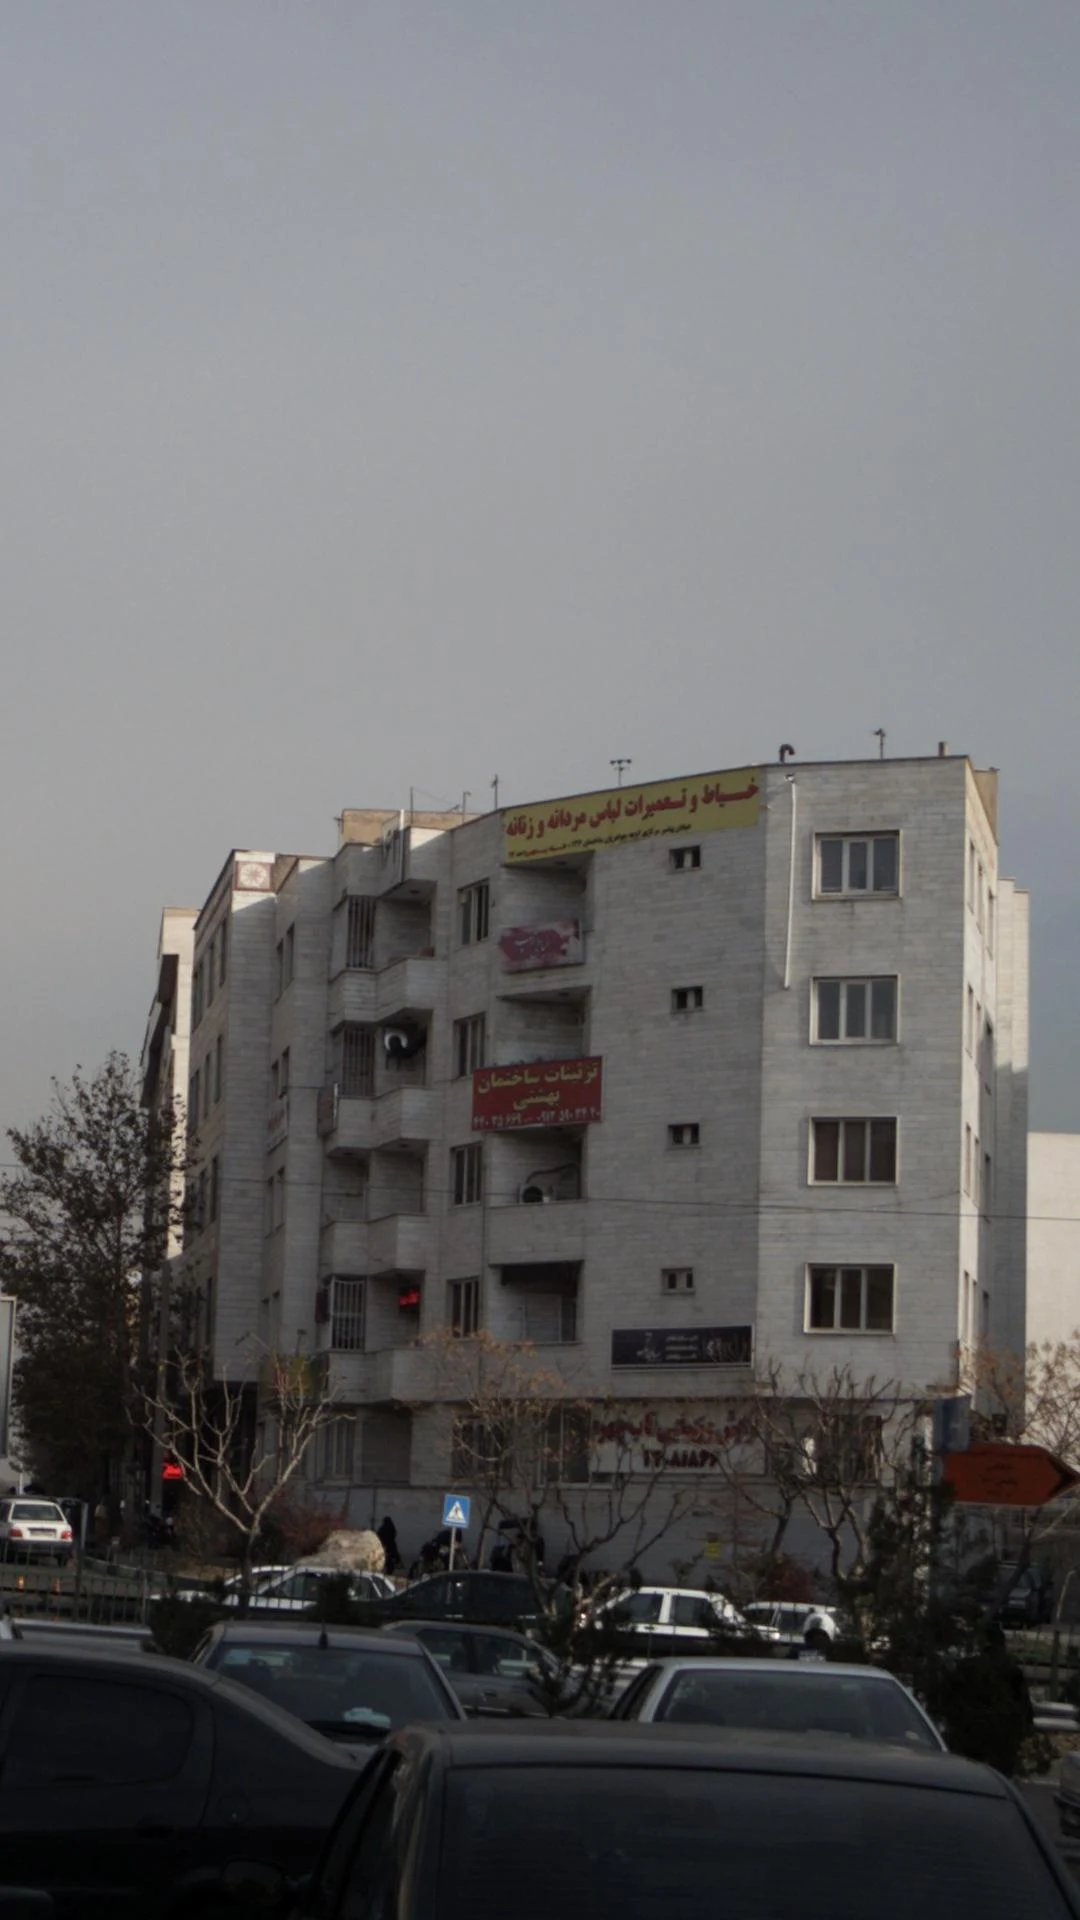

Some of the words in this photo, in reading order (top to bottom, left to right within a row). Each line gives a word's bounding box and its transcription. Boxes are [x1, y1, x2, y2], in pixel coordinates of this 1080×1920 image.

[624, 788, 687, 820] تعمیرات
[689, 794, 698, 813] و
[702, 777, 759, 807] خیاط
[547, 808, 587, 832] مردانه
[589, 797, 621, 828] لباس
[506, 814, 534, 840] زنانه
[536, 819, 545, 838] و
[477, 1069, 540, 1094] ساختمان
[512, 1088, 560, 1110] بهشتی
